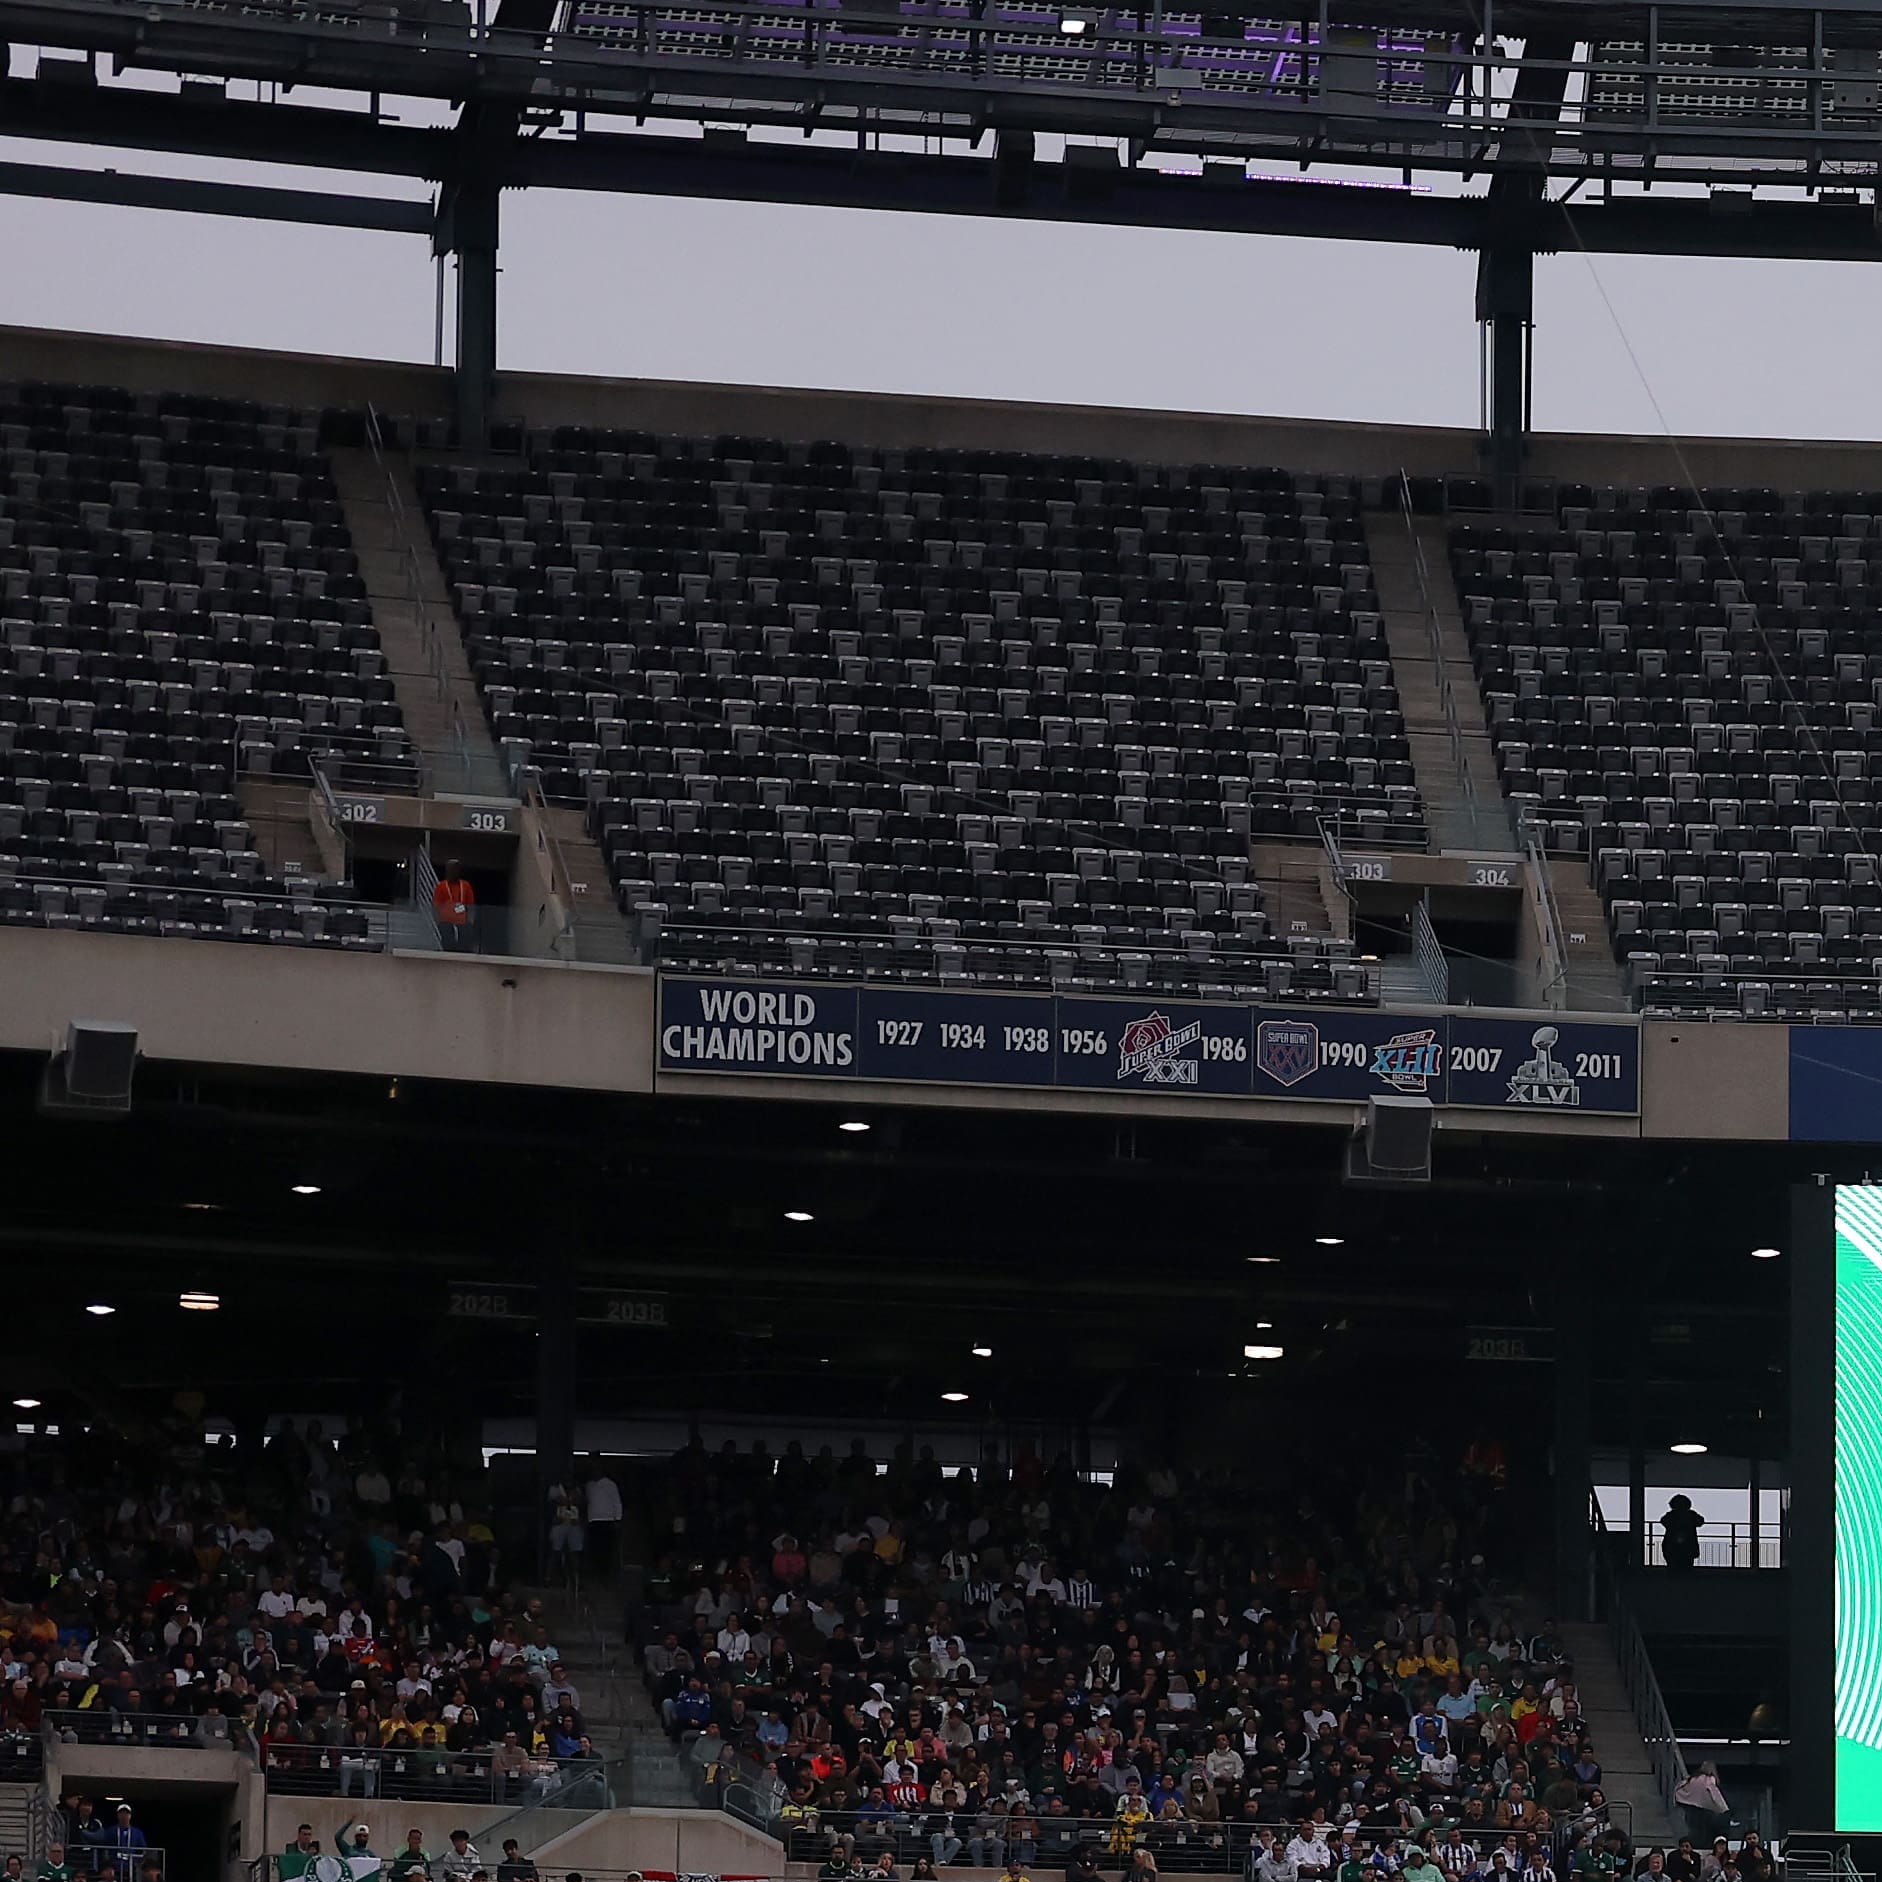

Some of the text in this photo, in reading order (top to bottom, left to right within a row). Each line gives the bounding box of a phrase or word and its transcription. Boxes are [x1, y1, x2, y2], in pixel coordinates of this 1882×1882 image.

[341, 803, 377, 821] 302
[470, 812, 505, 831] 303
[1350, 863, 1384, 880] 303
[1475, 868, 1509, 886] 304
[700, 988, 815, 1026] WORLD
[663, 1025, 853, 1066] CHAMPIONS
[877, 1019, 1622, 1078] 1927 1934 1938 1956 1986 1990 2007 2011
[1119, 1020, 1200, 1077] SUPER BOWL
[1144, 1058, 1198, 1084] XXI
[1504, 1081, 1580, 1106] XLVI
